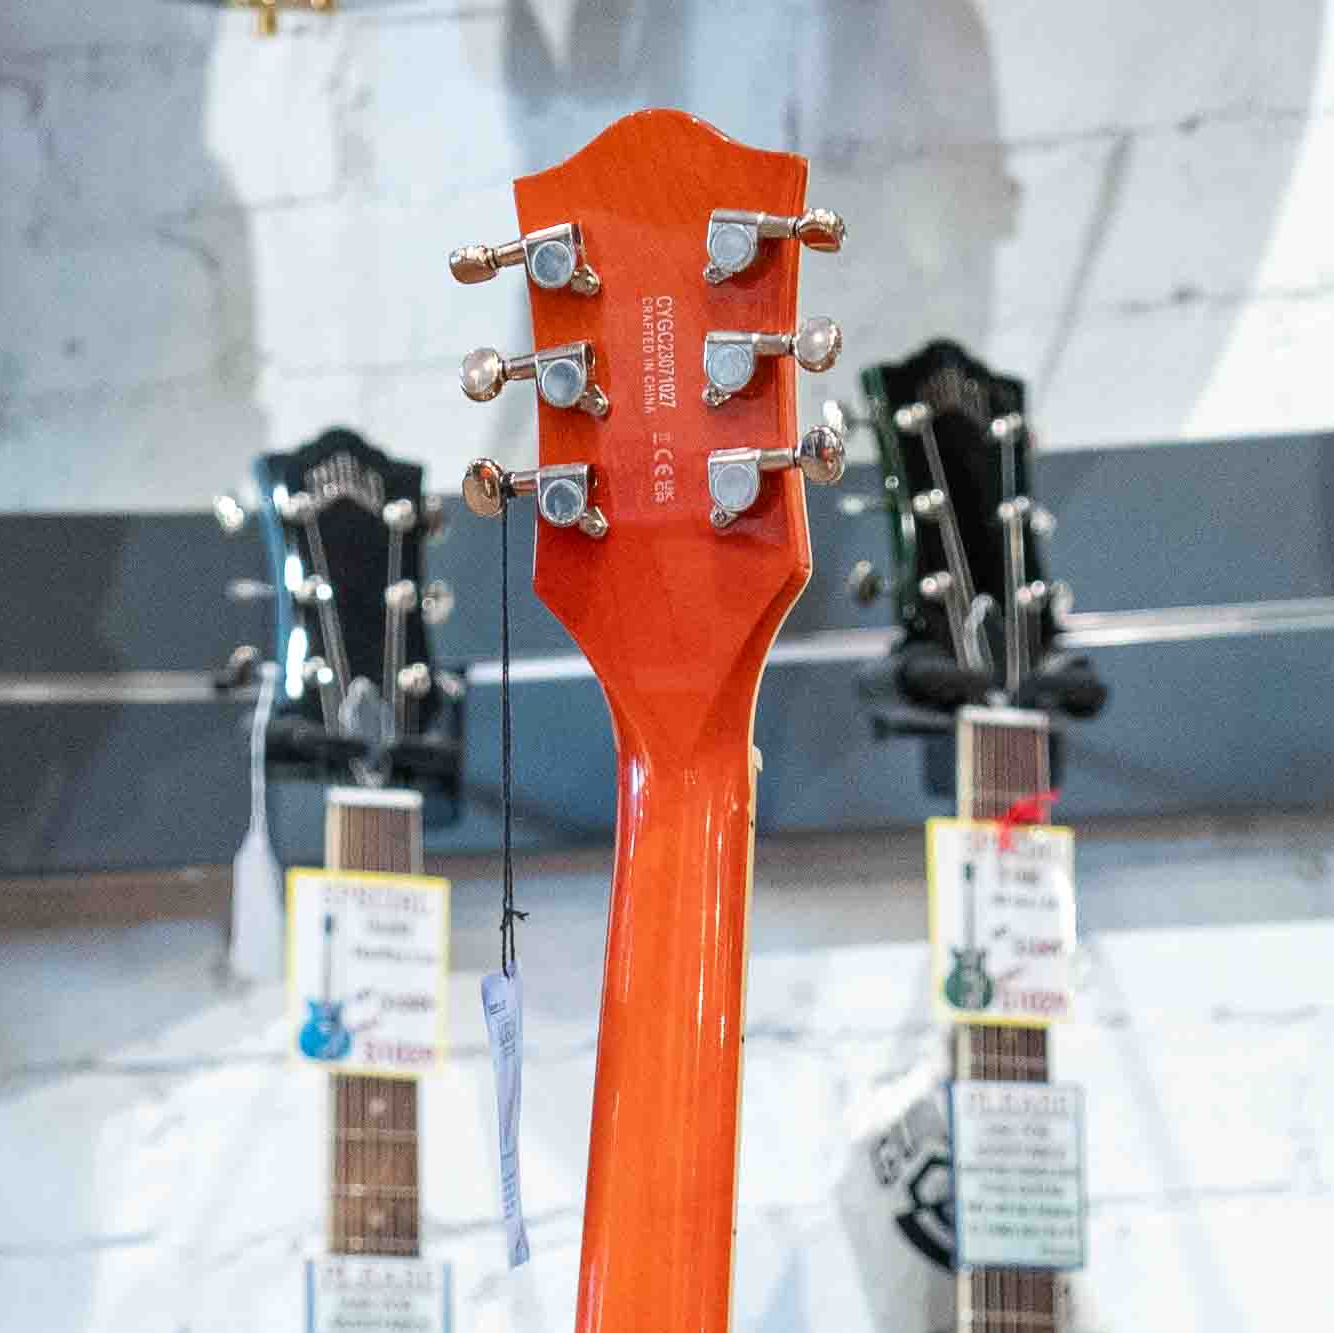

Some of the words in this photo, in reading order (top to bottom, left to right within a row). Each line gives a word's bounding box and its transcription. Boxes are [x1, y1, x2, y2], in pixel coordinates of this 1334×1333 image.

[642, 297, 655, 353] CRAFTED
[643, 359, 655, 371] IN
[644, 375, 657, 415] CHINA
